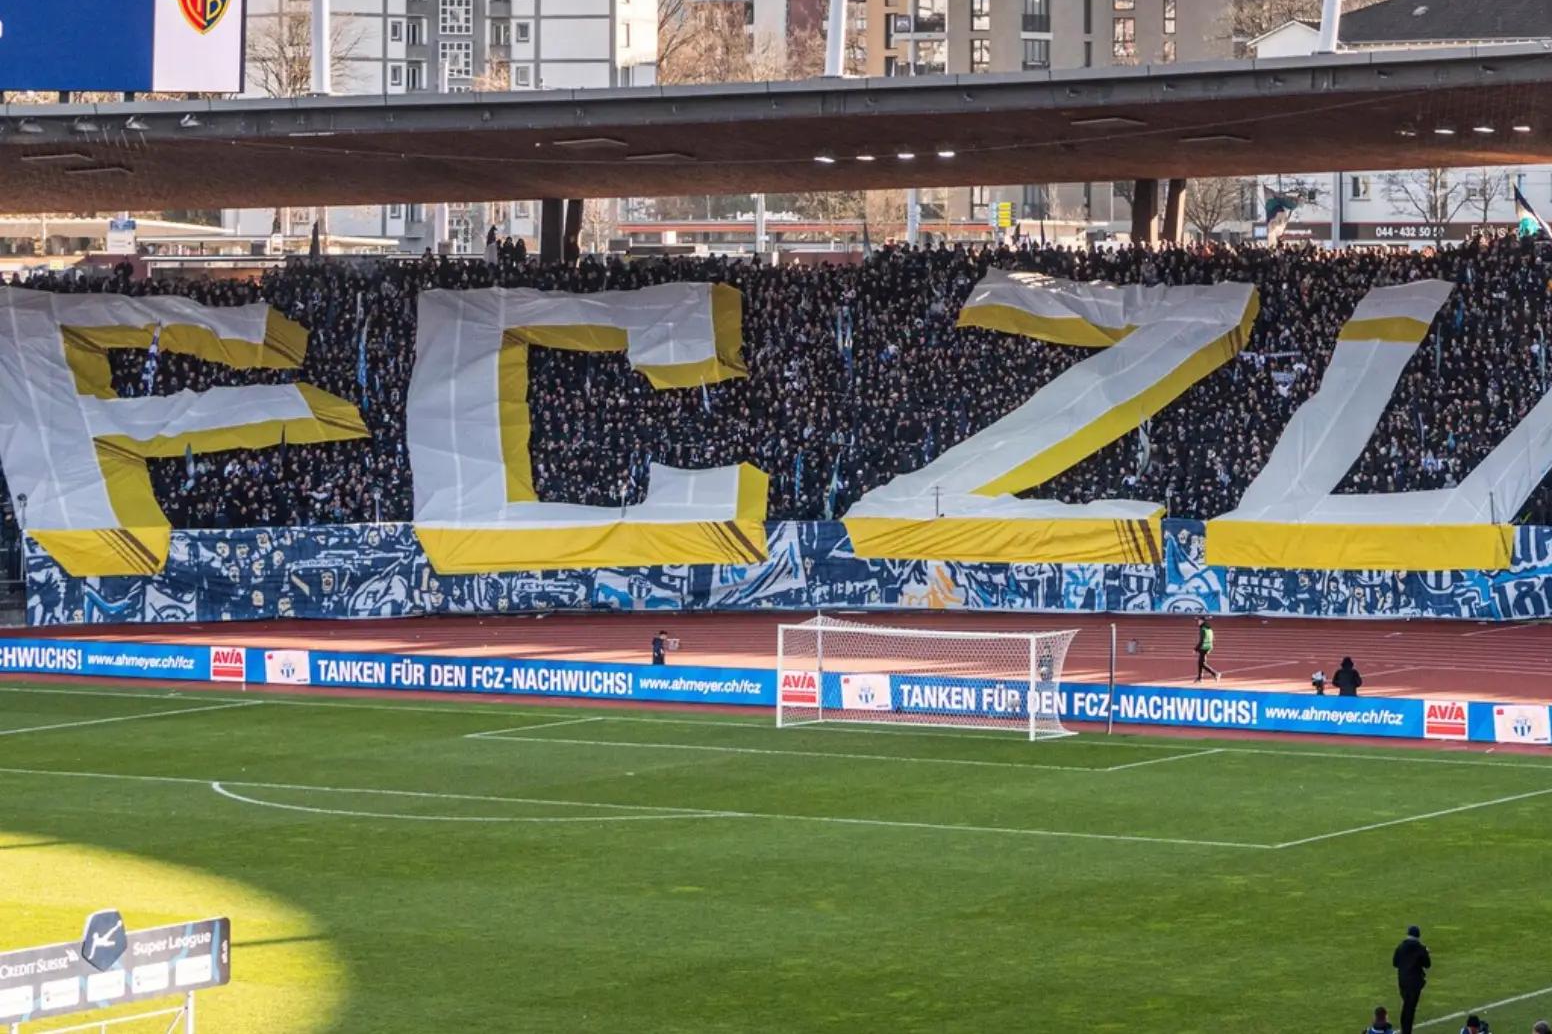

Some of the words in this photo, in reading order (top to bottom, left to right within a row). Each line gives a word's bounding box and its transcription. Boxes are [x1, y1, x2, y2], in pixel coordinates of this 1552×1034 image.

[0, 646, 83, 670] HWUCHS!
[87, 652, 195, 670] www.ahmeyer.ch/fcz
[318, 660, 386, 683] TANKEN
[391, 659, 425, 685] FÜR
[431, 664, 466, 687] DEN
[472, 666, 633, 695] FCZ-NACHWUCHS!
[639, 677, 761, 694] www.ahmeyer.ch/fcz
[900, 684, 976, 710] TANKEN
[982, 683, 1020, 713] FÜR
[1027, 691, 1067, 715] DEN
[1074, 692, 1257, 725] FCZ-NACHWUCHS!
[1265, 706, 1403, 726] www.ahmeyer.ch/fcz
[132, 939, 168, 956] Super
[169, 931, 212, 950] League
[36, 956, 68, 974] SUISSE
